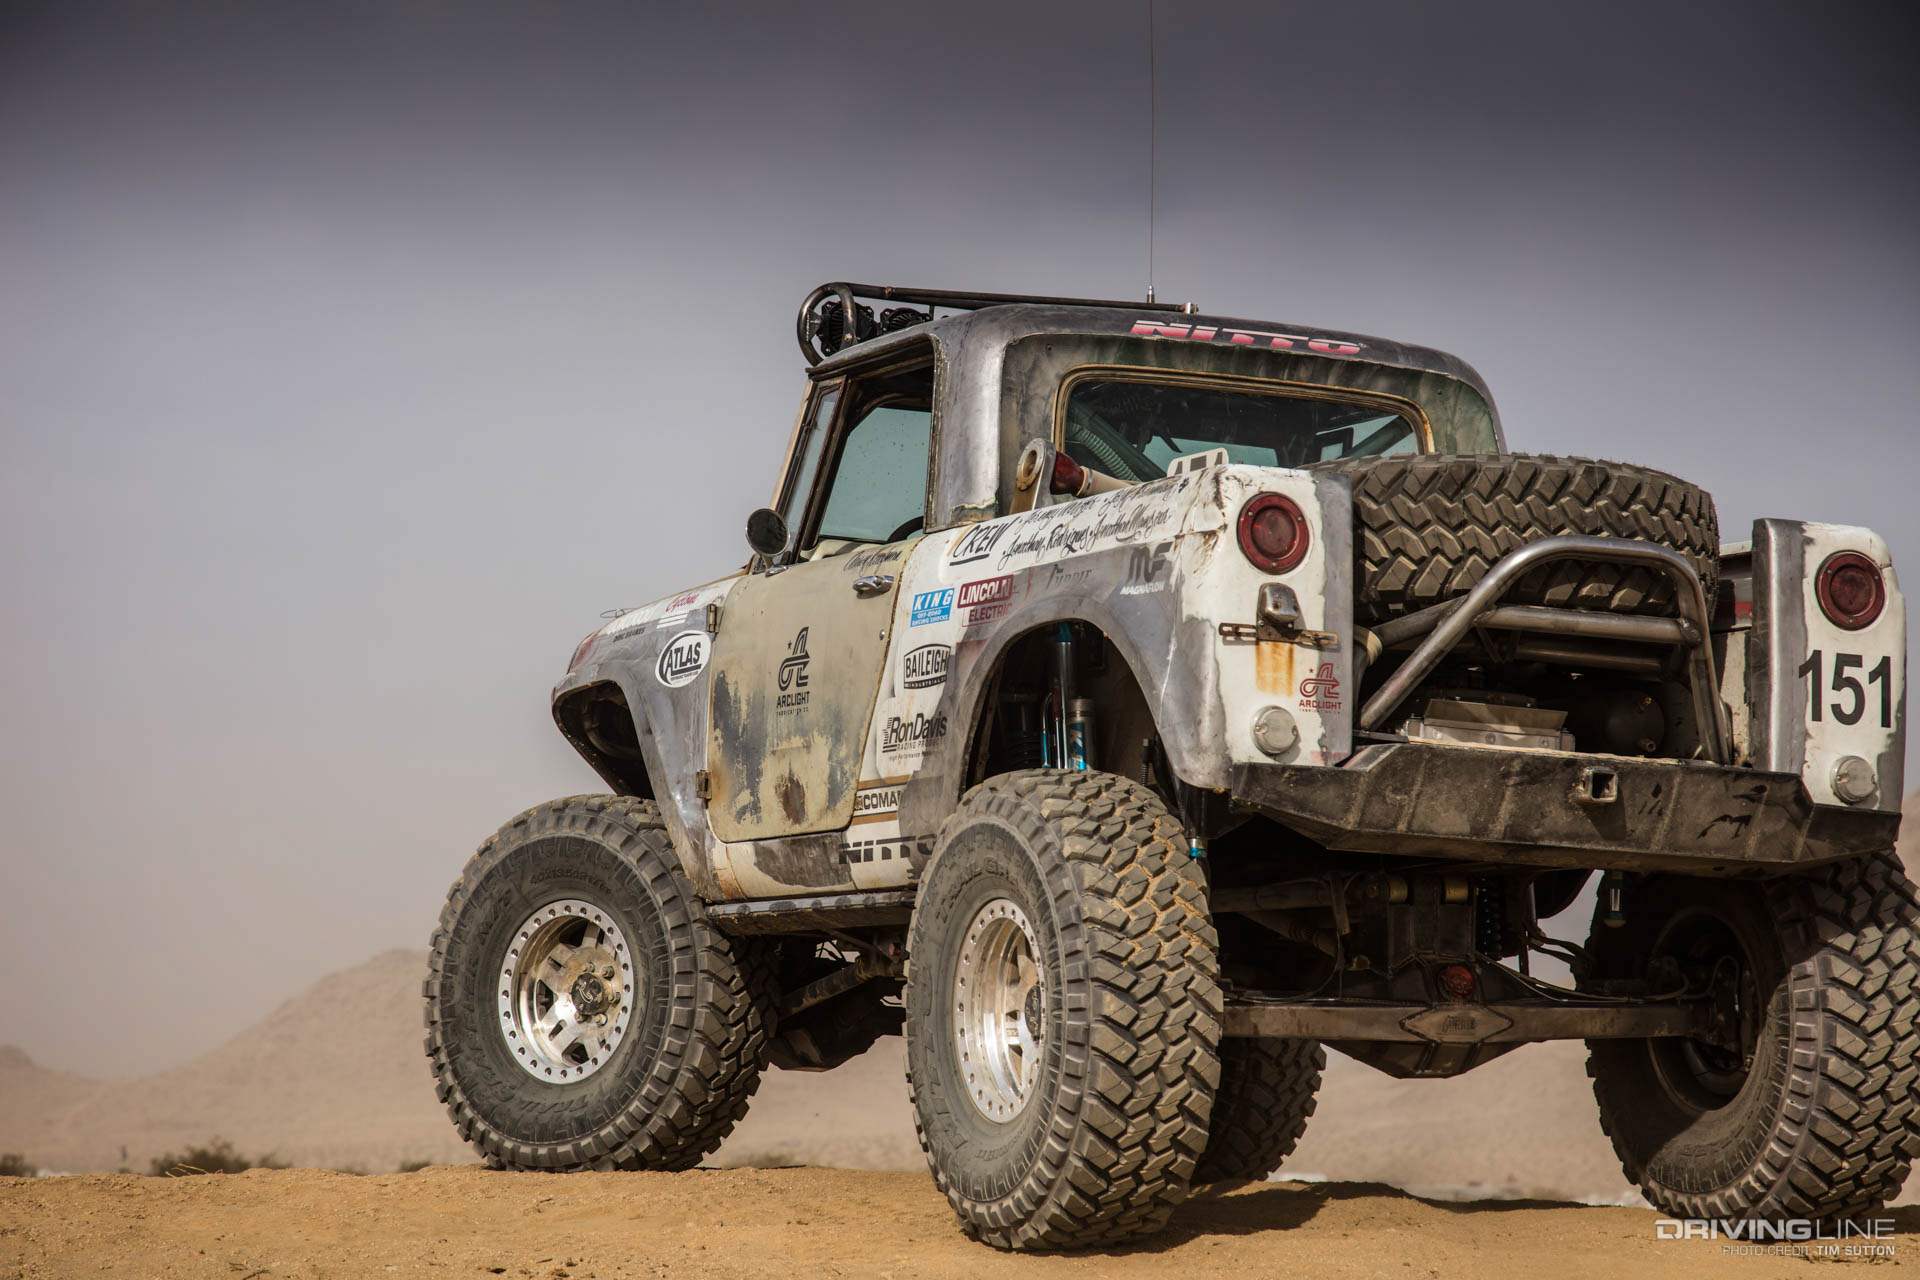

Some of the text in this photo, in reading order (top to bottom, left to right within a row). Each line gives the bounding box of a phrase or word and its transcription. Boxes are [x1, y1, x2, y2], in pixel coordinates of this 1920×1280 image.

[953, 516, 1020, 558] CREW
[914, 590, 954, 611] KING
[960, 578, 1012, 605] LINCOLN
[1120, 580, 1166, 595] MAGNAFLOW
[664, 642, 701, 671] ATLAS
[906, 649, 949, 678] BAILEIGH
[776, 691, 810, 709] ARCLIGHT
[1799, 649, 1891, 728] 151
[1299, 700, 1342, 710] ARCLIGHT
